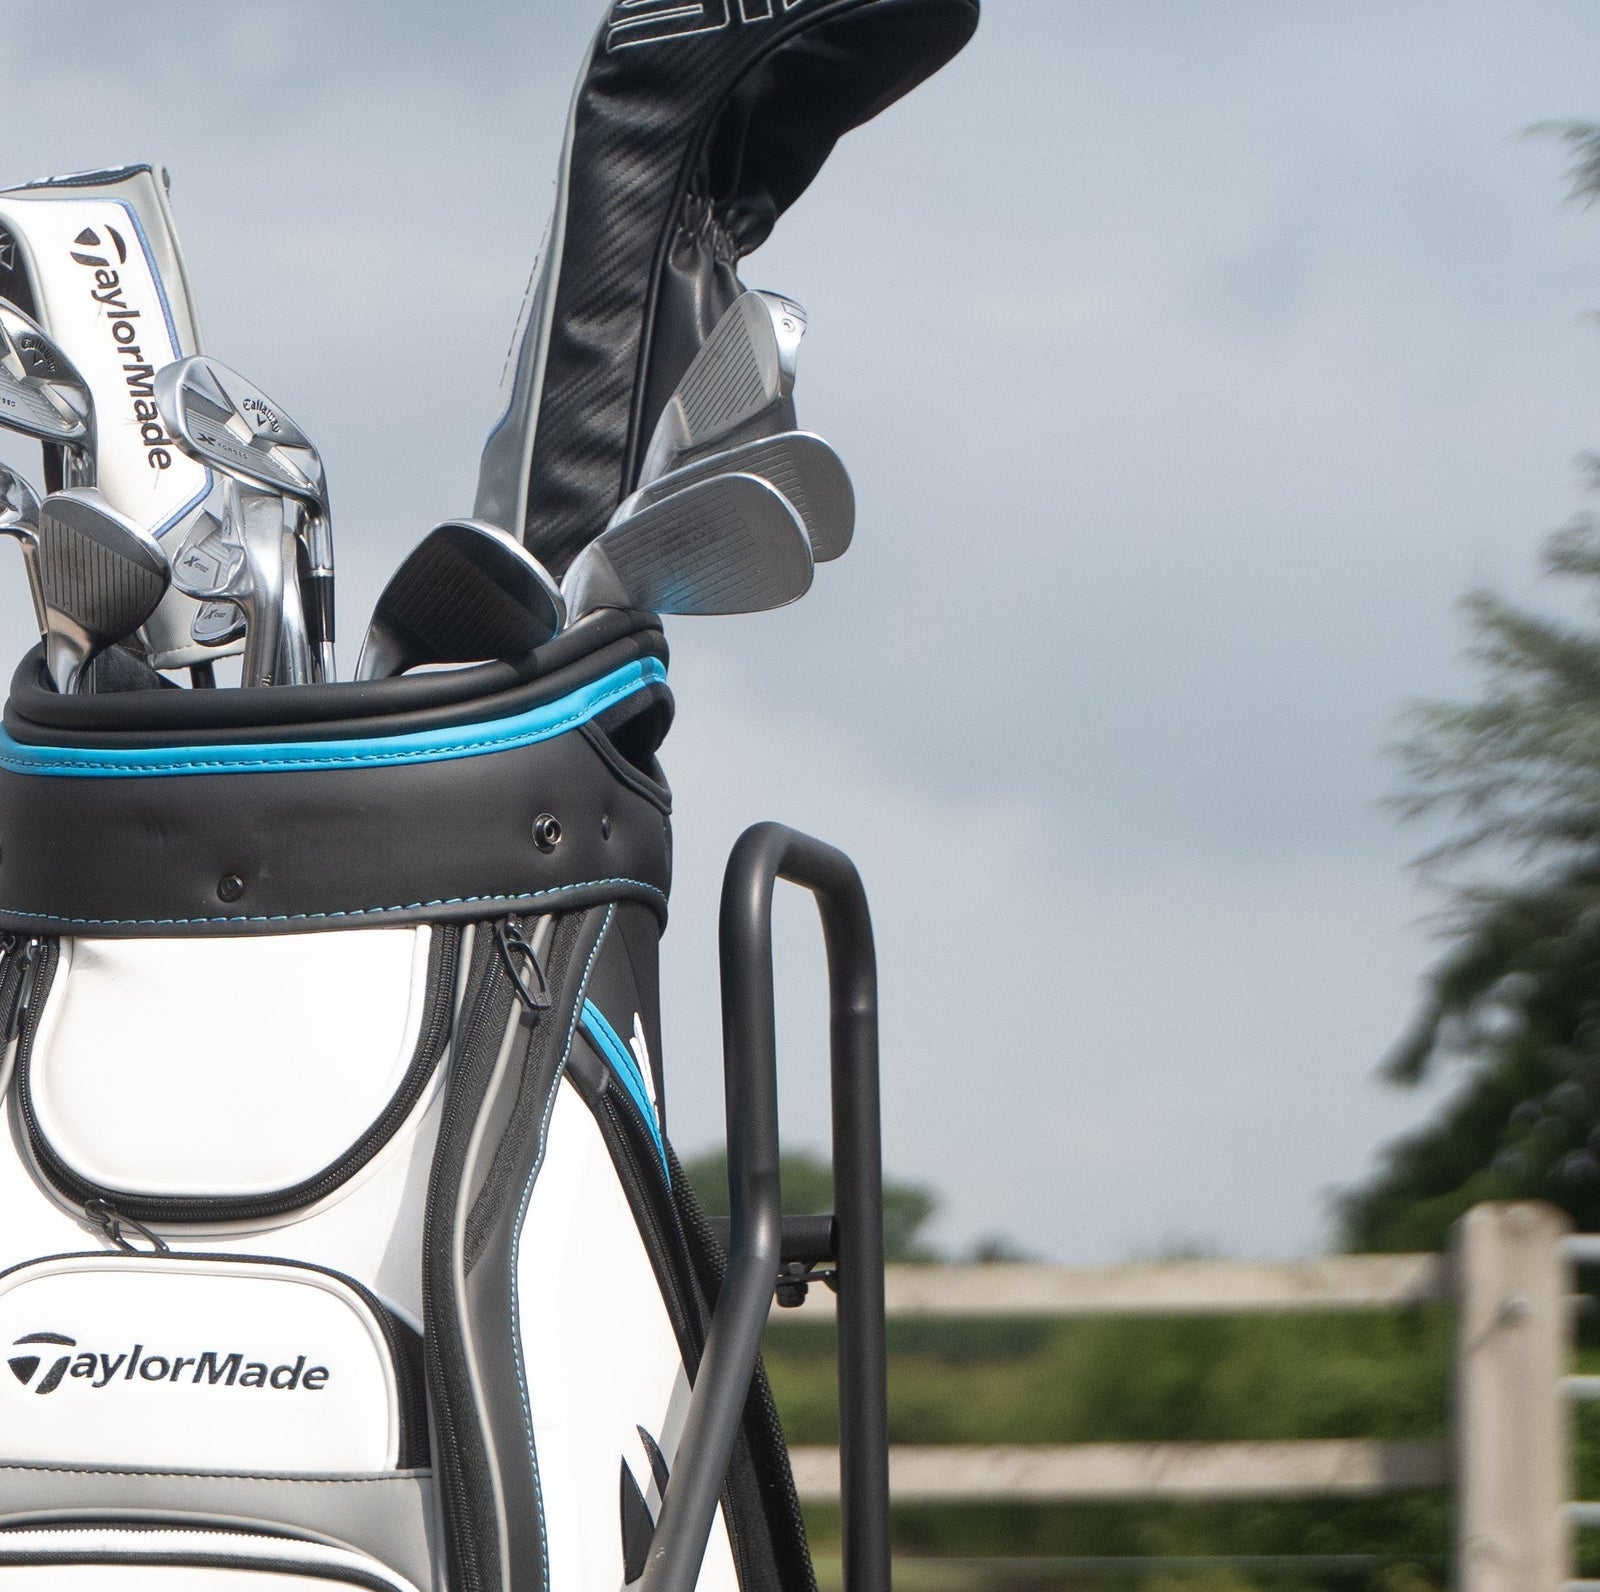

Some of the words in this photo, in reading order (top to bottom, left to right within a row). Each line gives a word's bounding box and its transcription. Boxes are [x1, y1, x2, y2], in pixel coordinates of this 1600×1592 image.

[70, 224, 173, 470] TaylorMade
[243, 398, 281, 433] Callaway
[7, 1332, 330, 1395] TaylorMade
